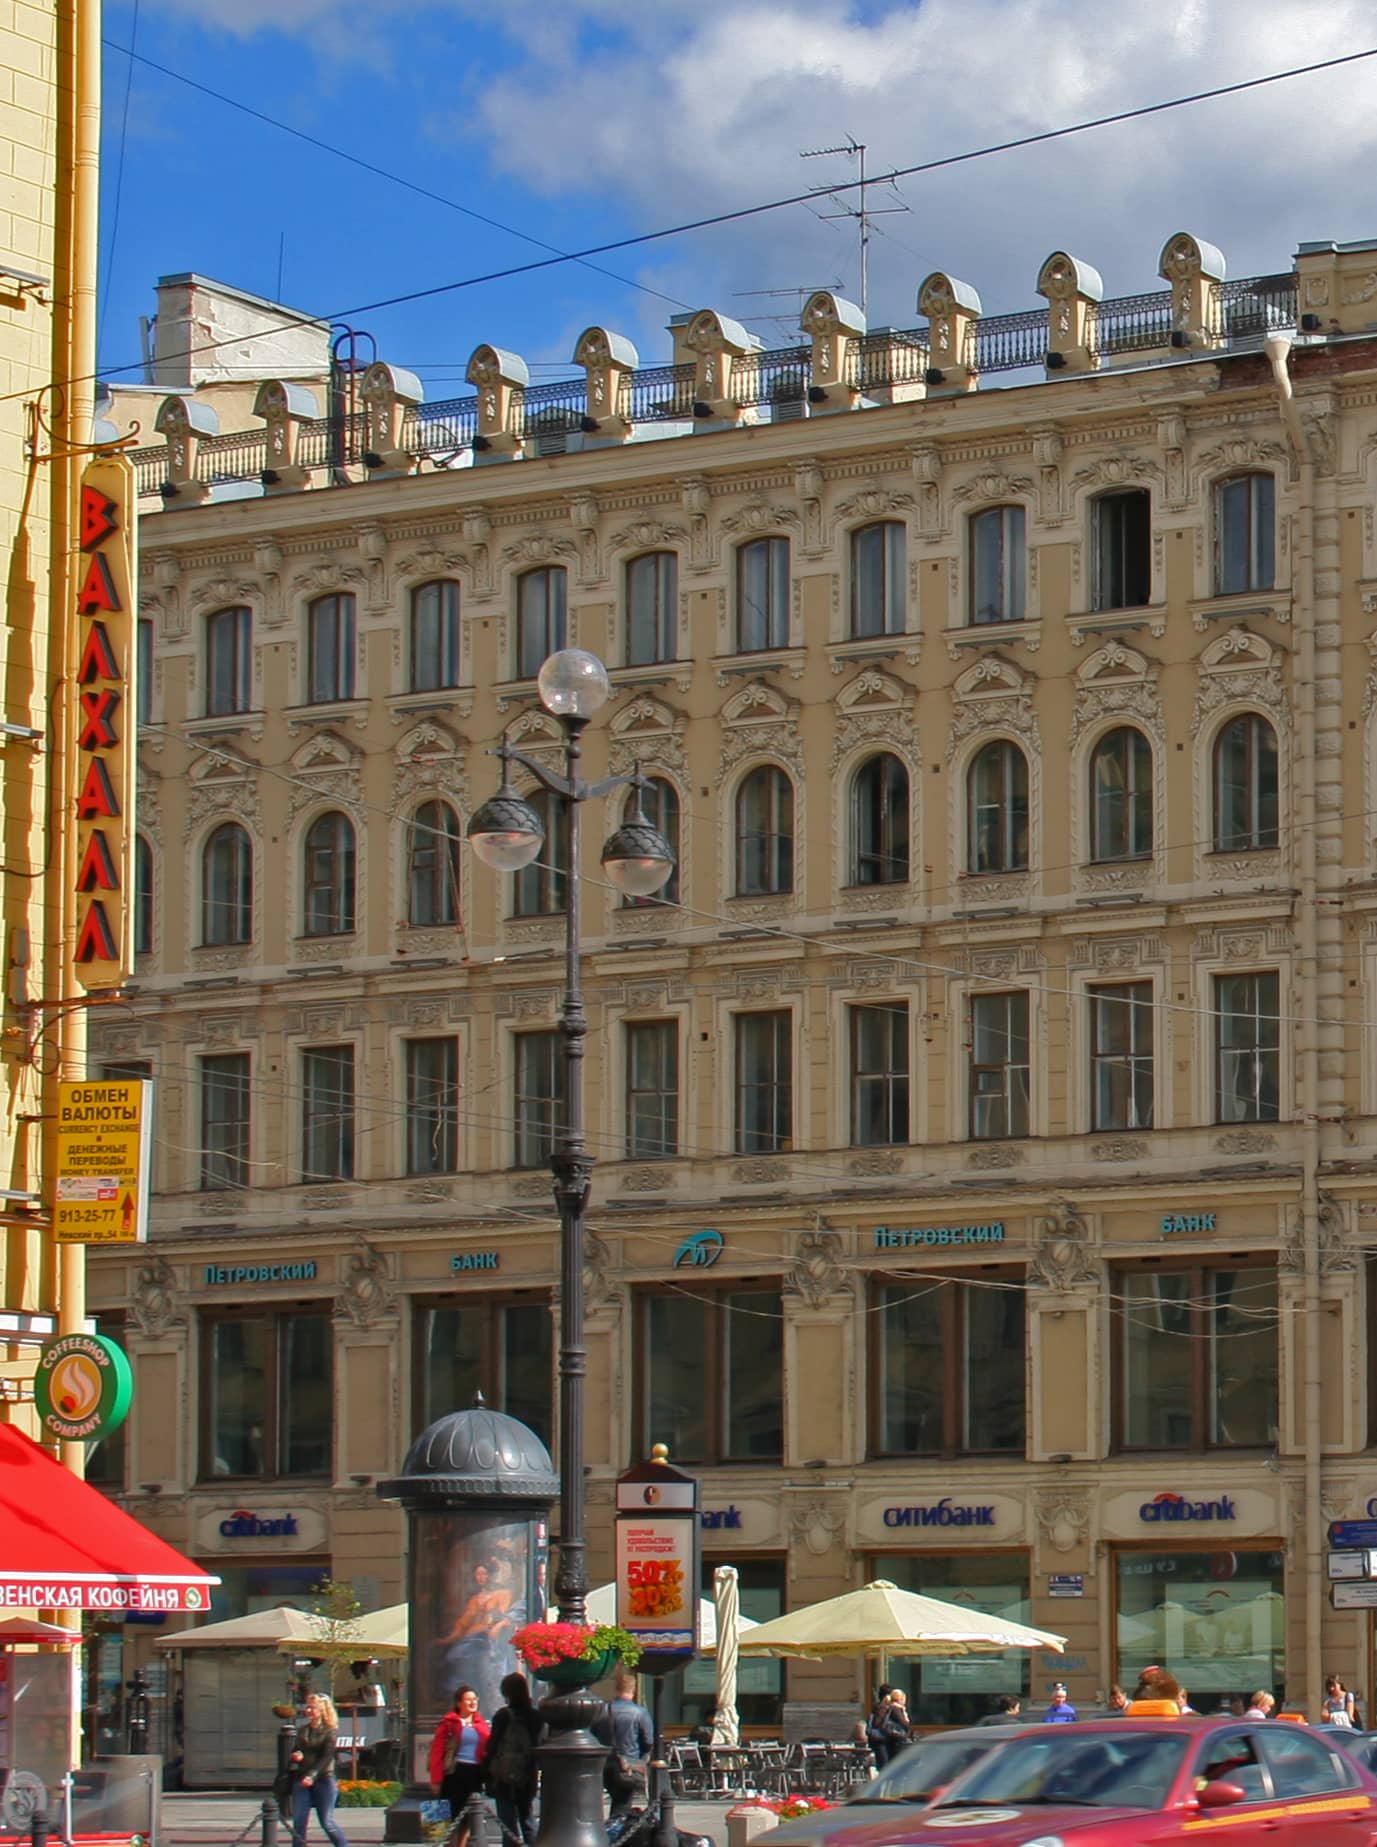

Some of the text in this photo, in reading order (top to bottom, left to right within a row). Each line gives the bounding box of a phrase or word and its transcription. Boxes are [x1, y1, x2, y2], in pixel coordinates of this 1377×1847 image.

[71, 1088, 128, 1103] ОБМЕН
[62, 1106, 136, 1121] ВАЛЮТЫ
[68, 1144, 127, 1155] ДЕНЕЖНЫЕ
[69, 1156, 126, 1166] ПЕРЕВОДЫ
[59, 1209, 116, 1223] 913-25-77
[1160, 1213, 1216, 1233] БАНК
[450, 1252, 498, 1271] БАНК
[46, 1413, 102, 1437] COMPANY
[883, 1498, 995, 1526] ситибанк
[1139, 1493, 1236, 1522] citibank
[219, 1511, 298, 1536] citibank
[88, 1585, 179, 1608] КОФЕЙНЯ
